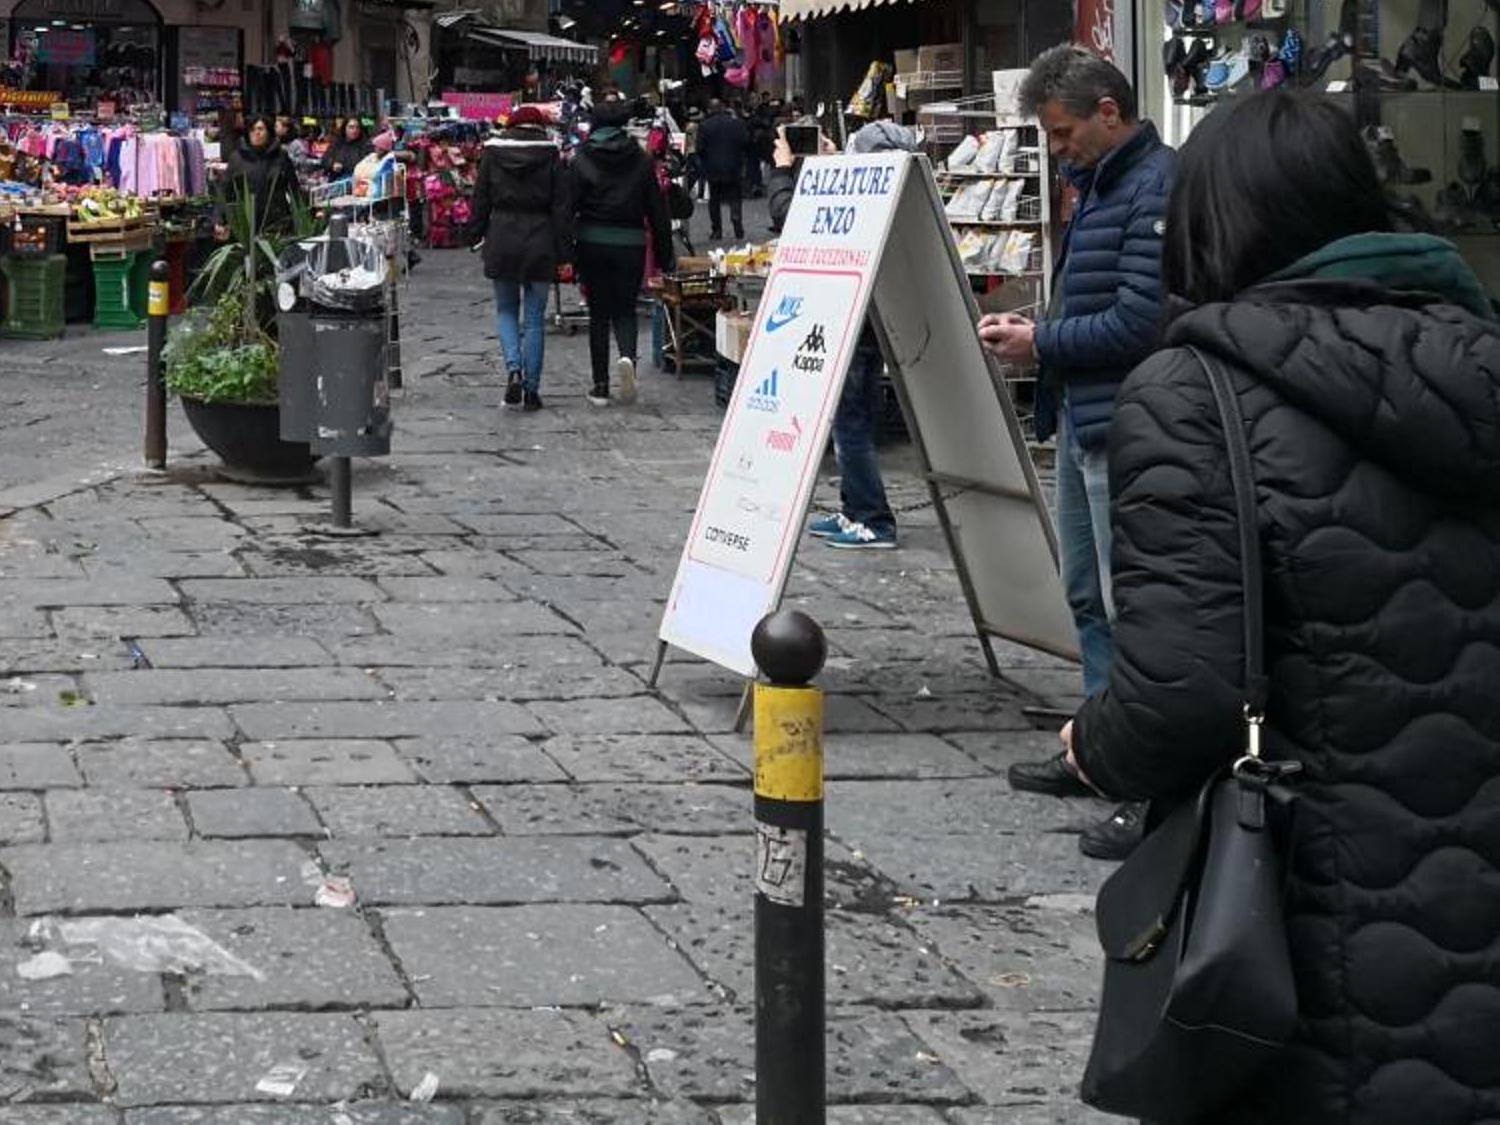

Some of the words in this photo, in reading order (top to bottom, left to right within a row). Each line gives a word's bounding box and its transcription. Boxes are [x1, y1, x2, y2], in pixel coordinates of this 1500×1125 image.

[800, 166, 894, 196] CALZATURE
[811, 206, 855, 235] ENZO
[776, 296, 804, 316] NIKE
[792, 354, 825, 373] Kappa
[705, 526, 751, 551] CONVERSE
